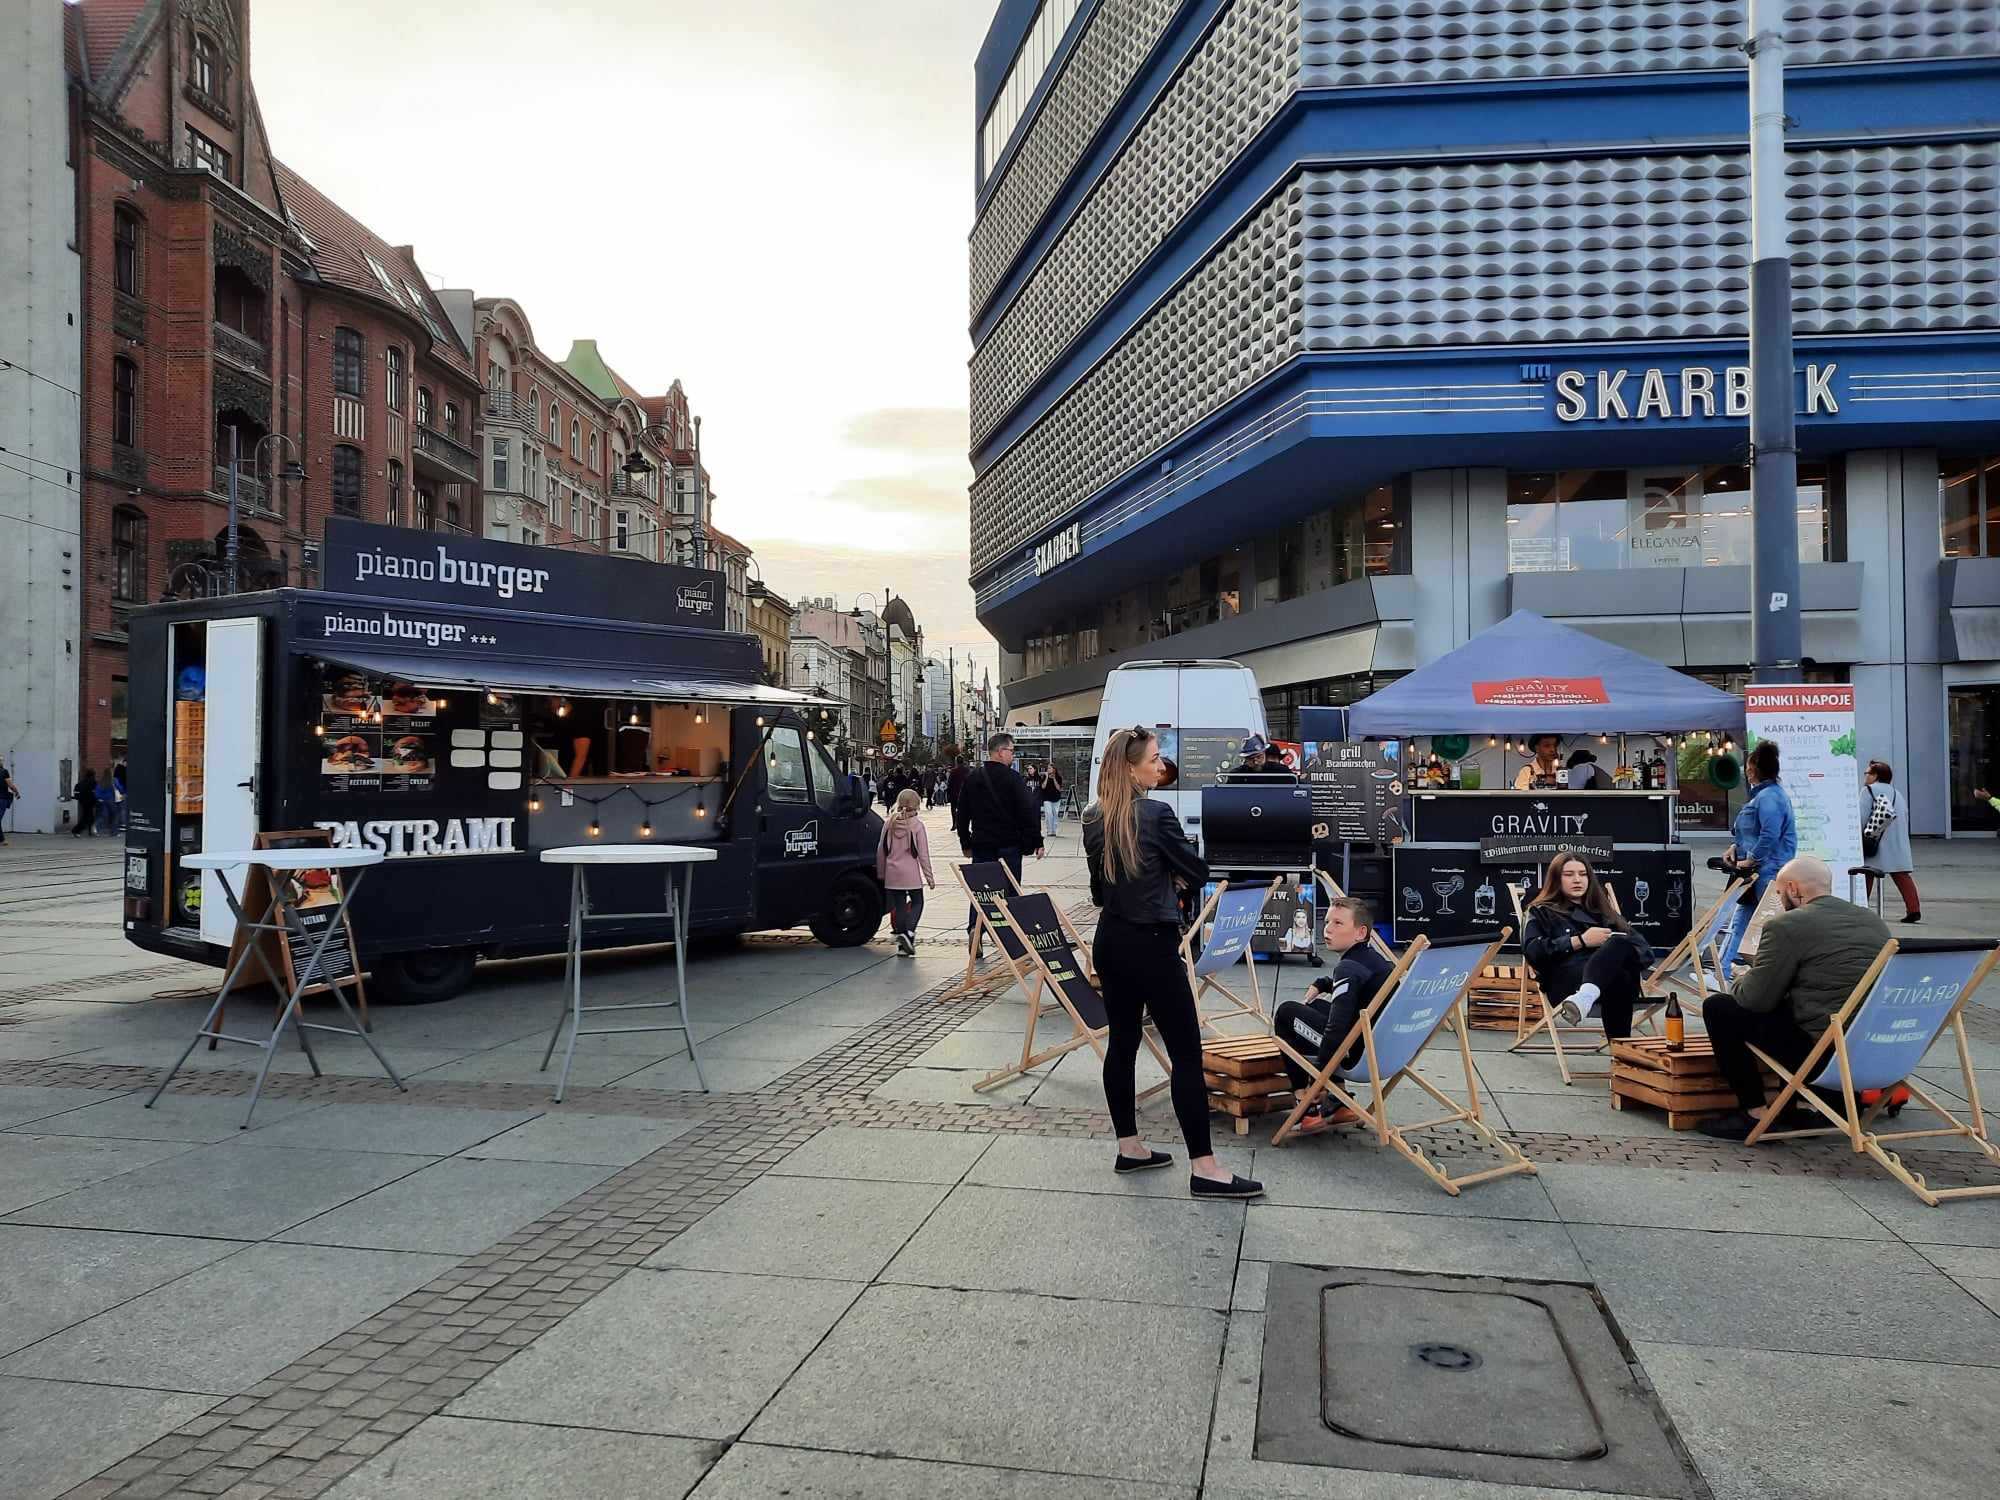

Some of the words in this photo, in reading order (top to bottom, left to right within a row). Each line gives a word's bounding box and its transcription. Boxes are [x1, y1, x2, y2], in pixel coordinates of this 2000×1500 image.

[1556, 364, 1839, 421] SKARBK
[1035, 522, 1081, 577] SKARBEK
[1631, 535, 1701, 550] ELEGANZA
[685, 589, 707, 599] piano
[678, 596, 714, 613] burger
[1748, 695, 1793, 707] DRINKI
[1795, 695, 1800, 706] i
[1801, 694, 1851, 706] NAPOJE
[1764, 724, 1795, 733] KARTA
[884, 745, 896, 754] 20
[1340, 745, 1361, 760] grill
[1491, 813, 1588, 835] GRAVITY
[313, 817, 516, 858] PASTRAMI
[791, 831, 812, 843] piano
[785, 839, 818, 854] burger
[1483, 844, 1538, 858] Willkommen
